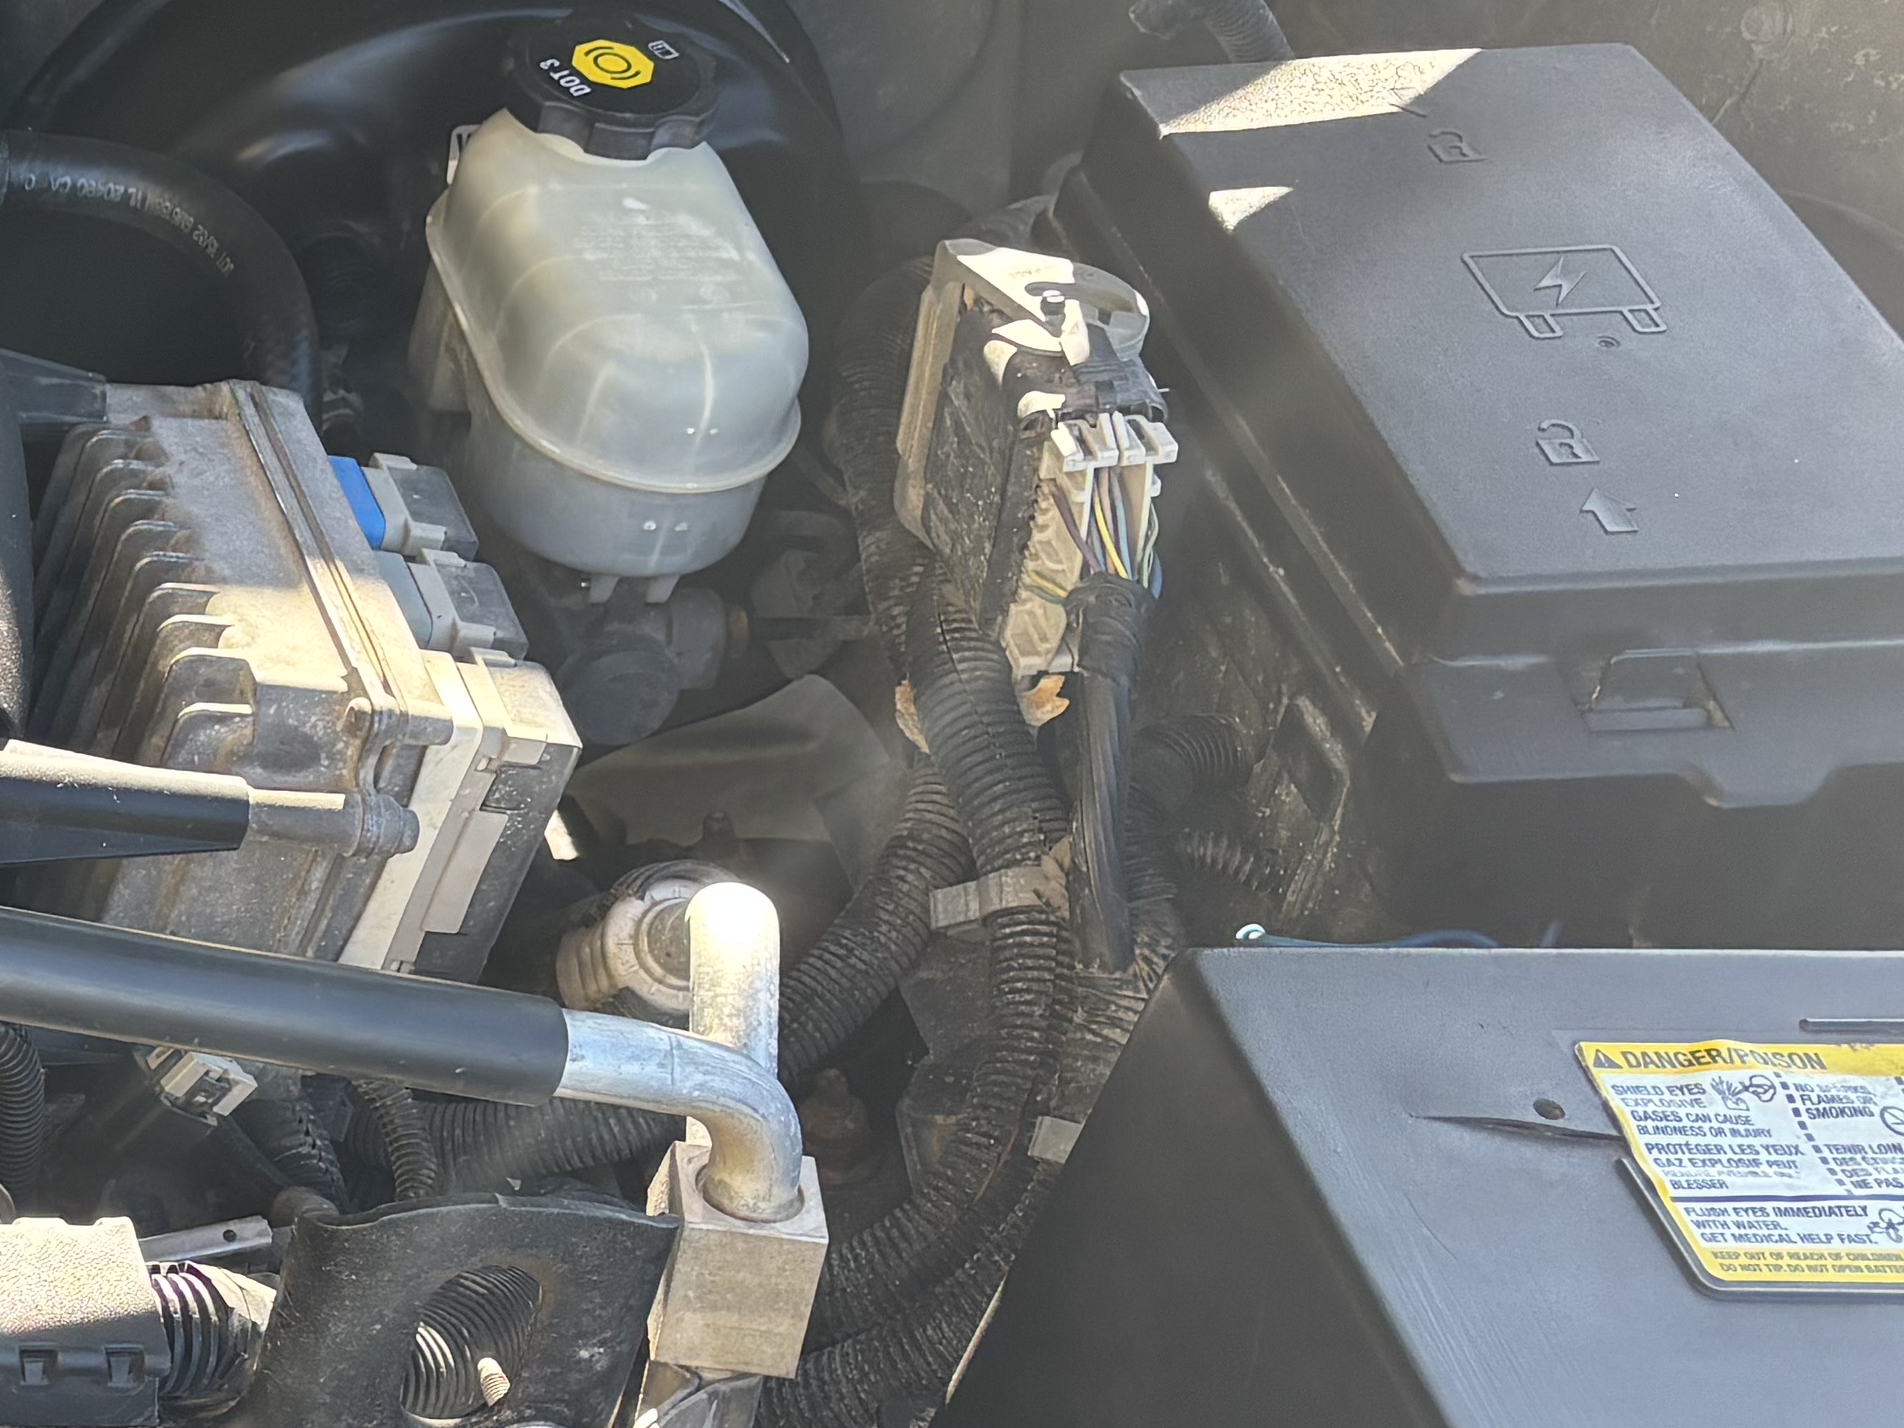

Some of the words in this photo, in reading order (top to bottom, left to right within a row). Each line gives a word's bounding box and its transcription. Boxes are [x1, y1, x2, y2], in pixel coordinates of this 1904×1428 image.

[539, 58, 560, 70] 3
[549, 69, 592, 97] DOT
[1620, 1047, 1828, 1071] DANGER/POISON
[1611, 1084, 1665, 1096] SHIELD
[1666, 1083, 1707, 1096] EYES
[1623, 1098, 1707, 1109] EXPLOSIVE
[1800, 1094, 1854, 1106] FLAMES
[1630, 1110, 1683, 1123] GASES
[1685, 1112, 1712, 1124] CAN
[1715, 1113, 1753, 1126] CAUSE
[1805, 1106, 1875, 1120] SMOKING
[1637, 1125, 1707, 1137] BLINDNESS
[1710, 1126, 1727, 1137] OR
[1730, 1127, 1773, 1139] INJURY
[1645, 1140, 1728, 1156] PROTÉGER
[1732, 1144, 1757, 1155] LES
[1760, 1143, 1806, 1156] YEUX
[1823, 1144, 1868, 1155] TENIR
[1654, 1158, 1684, 1169] GAZ
[1691, 1158, 1763, 1169] EXPLOSIF
[1766, 1159, 1799, 1170] PEUT
[1670, 1179, 1730, 1190] BLESSER
[1850, 1179, 1873, 1189] NE
[1874, 1177, 1904, 1189] PAS
[1684, 1206, 1731, 1218] FLUSH
[1734, 1206, 1770, 1218] EYES
[1773, 1205, 1870, 1218] IMMEDIATELY
[1692, 1219, 1732, 1231] WITH
[1734, 1219, 1789, 1231] WATER.
[1701, 1232, 1728, 1243] GET
[1732, 1232, 1795, 1244] MEDICAL
[1796, 1233, 1834, 1244] HELP
[1839, 1233, 1880, 1245] FAST.
[1712, 1251, 1741, 1260] KEEP
[1743, 1251, 1767, 1261] OUT
[1769, 1251, 1784, 1261] OF
[1786, 1252, 1827, 1261] REACH
[1828, 1252, 1843, 1261] OF
[1720, 1263, 1738, 1273] DO
[1740, 1263, 1764, 1273] NOT
[1803, 1263, 1831, 1273] NOT
[1832, 1263, 1865, 1274] OPEN
[1866, 1264, 1904, 1274] BATTE
